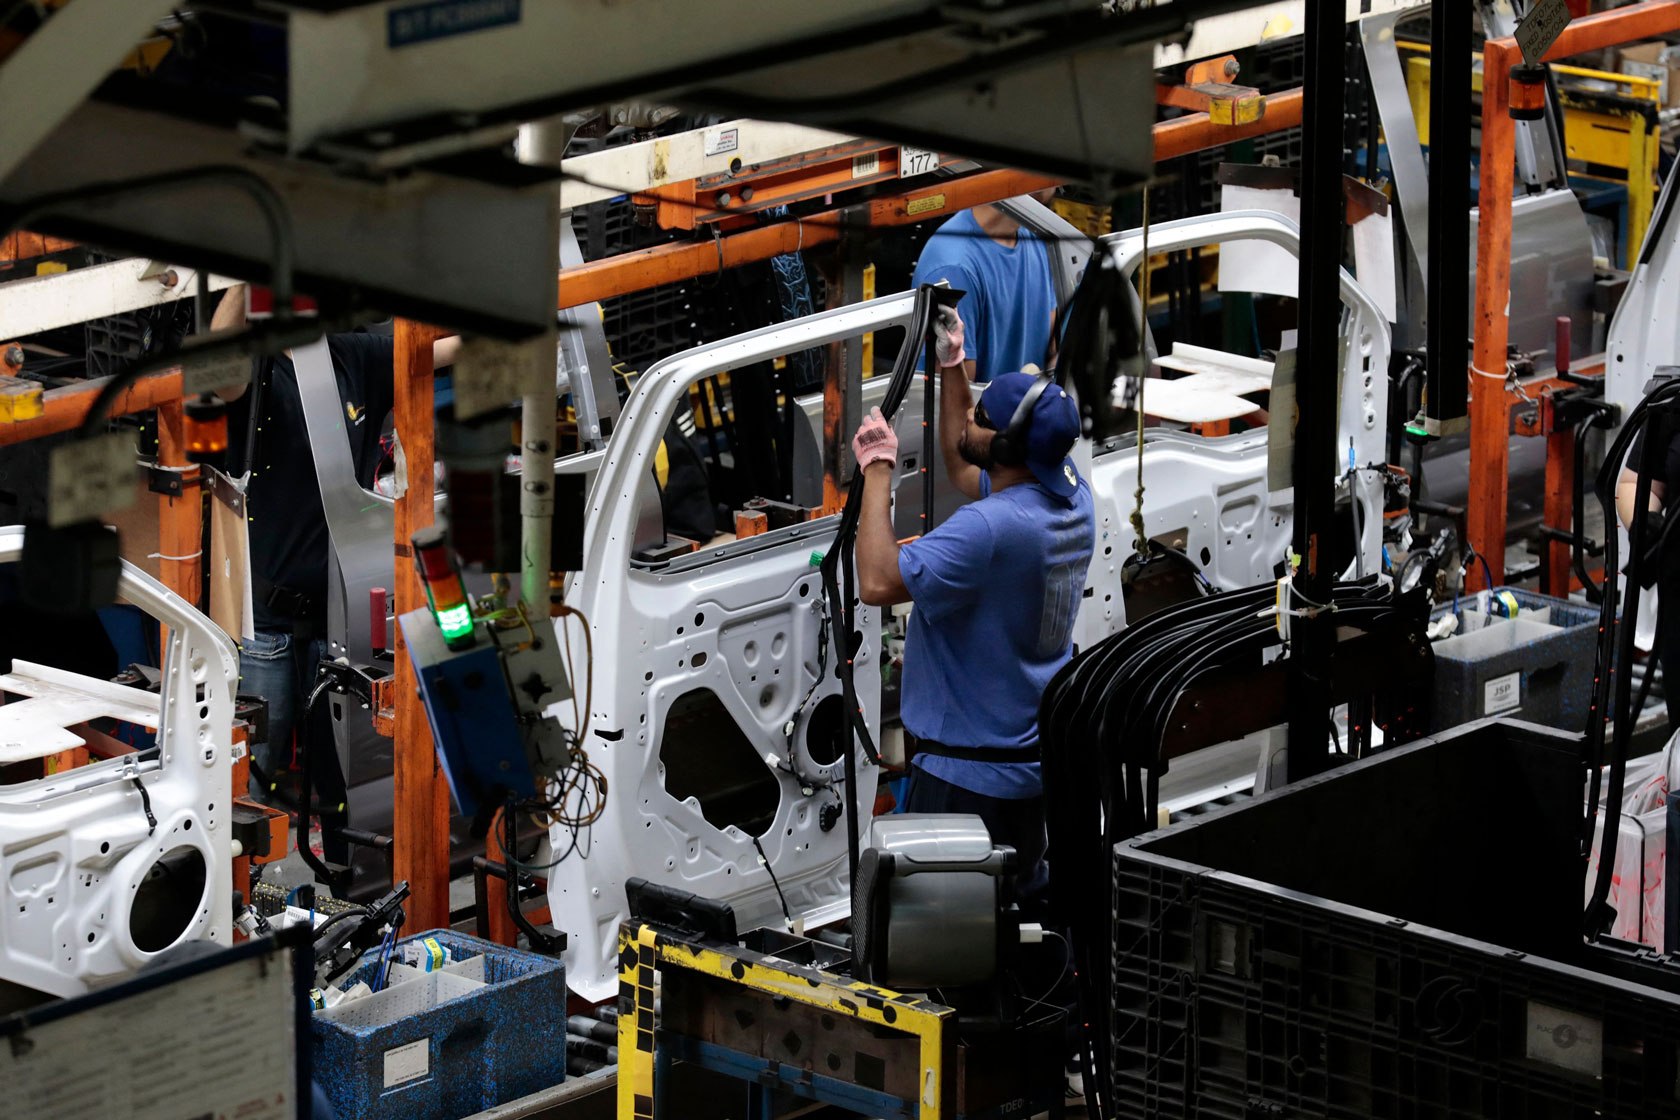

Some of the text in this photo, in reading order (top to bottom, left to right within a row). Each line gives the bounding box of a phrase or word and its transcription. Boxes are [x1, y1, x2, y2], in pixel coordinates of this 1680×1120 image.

[910, 153, 931, 174] 177
[1494, 684, 1511, 697] JSP
[1000, 1098, 1025, 1115] TDE0
